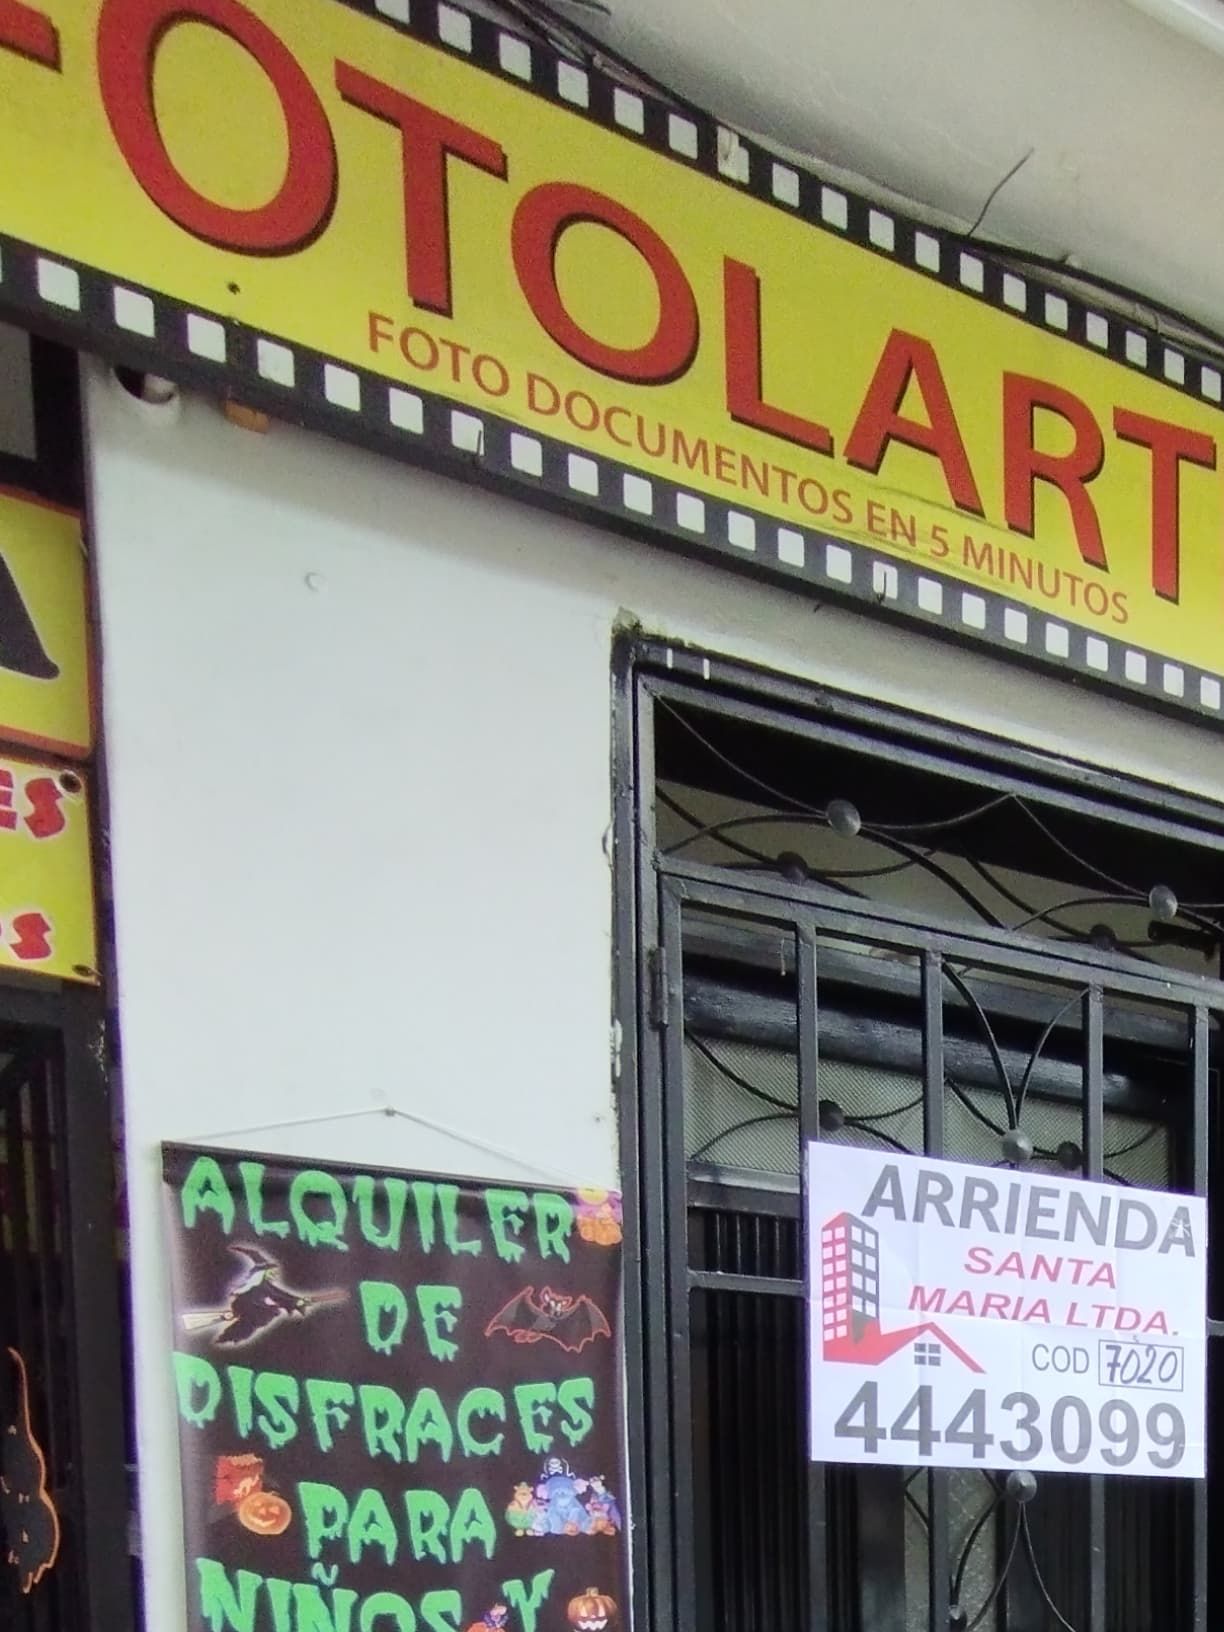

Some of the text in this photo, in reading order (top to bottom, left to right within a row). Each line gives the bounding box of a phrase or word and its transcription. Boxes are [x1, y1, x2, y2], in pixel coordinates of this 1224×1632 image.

[368, 312, 1129, 625] FOTO DOCUMENTOS EN 5 MINUTOS
[181, 1156, 573, 1264] ALQUILER
[861, 1164, 1196, 1257] ARRIENDA
[907, 1285, 1180, 1336] MARIA LTDA.
[964, 1246, 1117, 1289] SANTA
[358, 1280, 463, 1361] DE
[1031, 1343, 1179, 1384] COD 7020
[172, 1350, 595, 1463] DISFRACES
[833, 1380, 1186, 1470] 4443099
[296, 1481, 496, 1566] PARA
